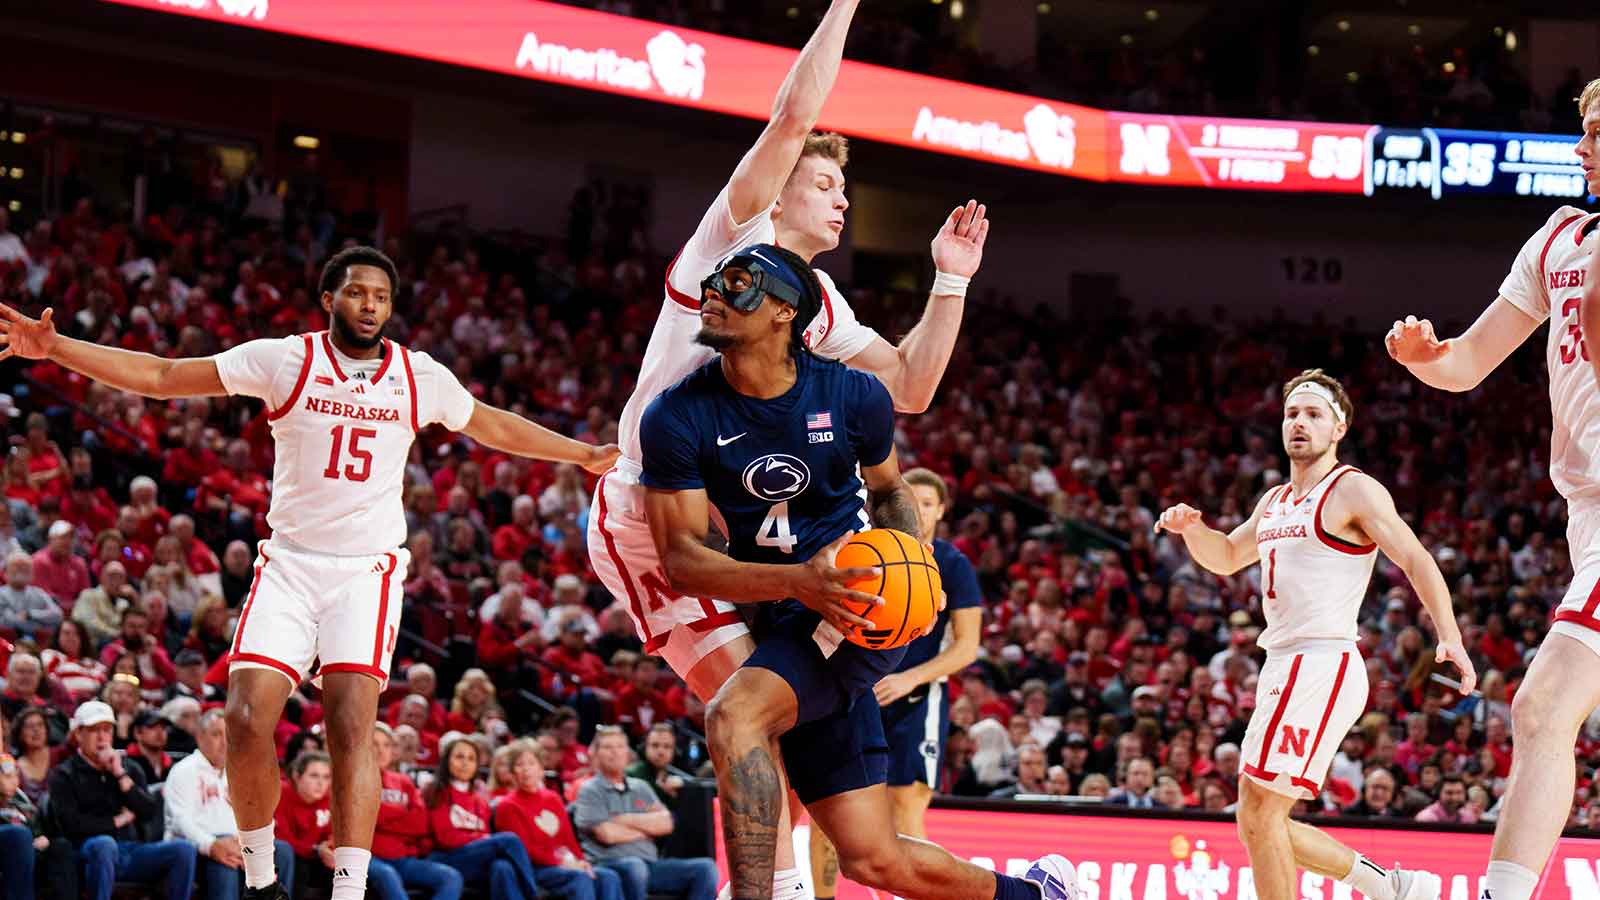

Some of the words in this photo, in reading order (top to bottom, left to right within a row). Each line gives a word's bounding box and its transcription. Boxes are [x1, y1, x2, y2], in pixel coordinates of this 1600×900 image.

[515, 32, 651, 90] Ameritas
[1442, 143, 1496, 187] 35
[1280, 257, 1343, 283] 120
[305, 396, 400, 421] NEBRASKA
[323, 425, 377, 482] 15
[755, 500, 798, 553] 4
[1267, 548, 1277, 599] 1
[1278, 724, 1310, 757] N
